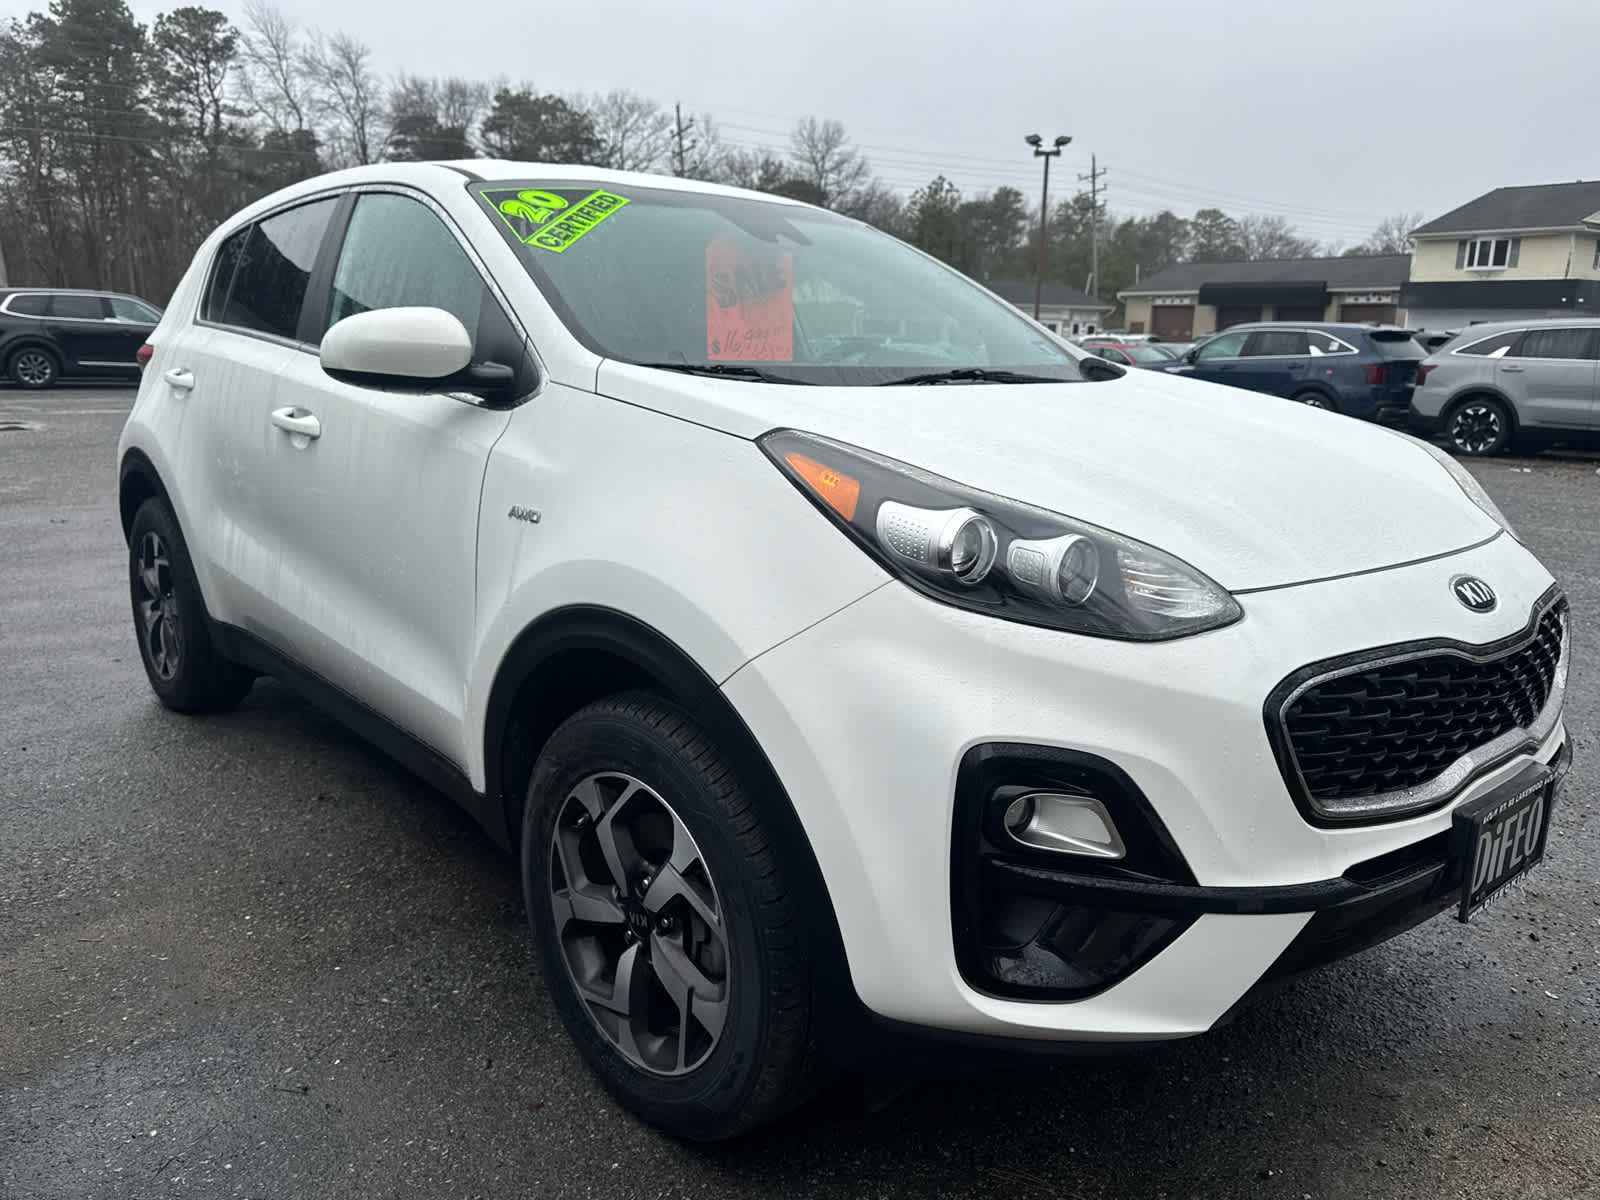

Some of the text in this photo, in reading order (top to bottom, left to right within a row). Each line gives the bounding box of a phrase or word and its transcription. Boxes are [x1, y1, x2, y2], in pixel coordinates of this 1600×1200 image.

[500, 189, 569, 224] 20
[536, 193, 619, 248] CERTIFIED
[508, 505, 542, 524] AWD
[629, 911, 648, 928] KIA
